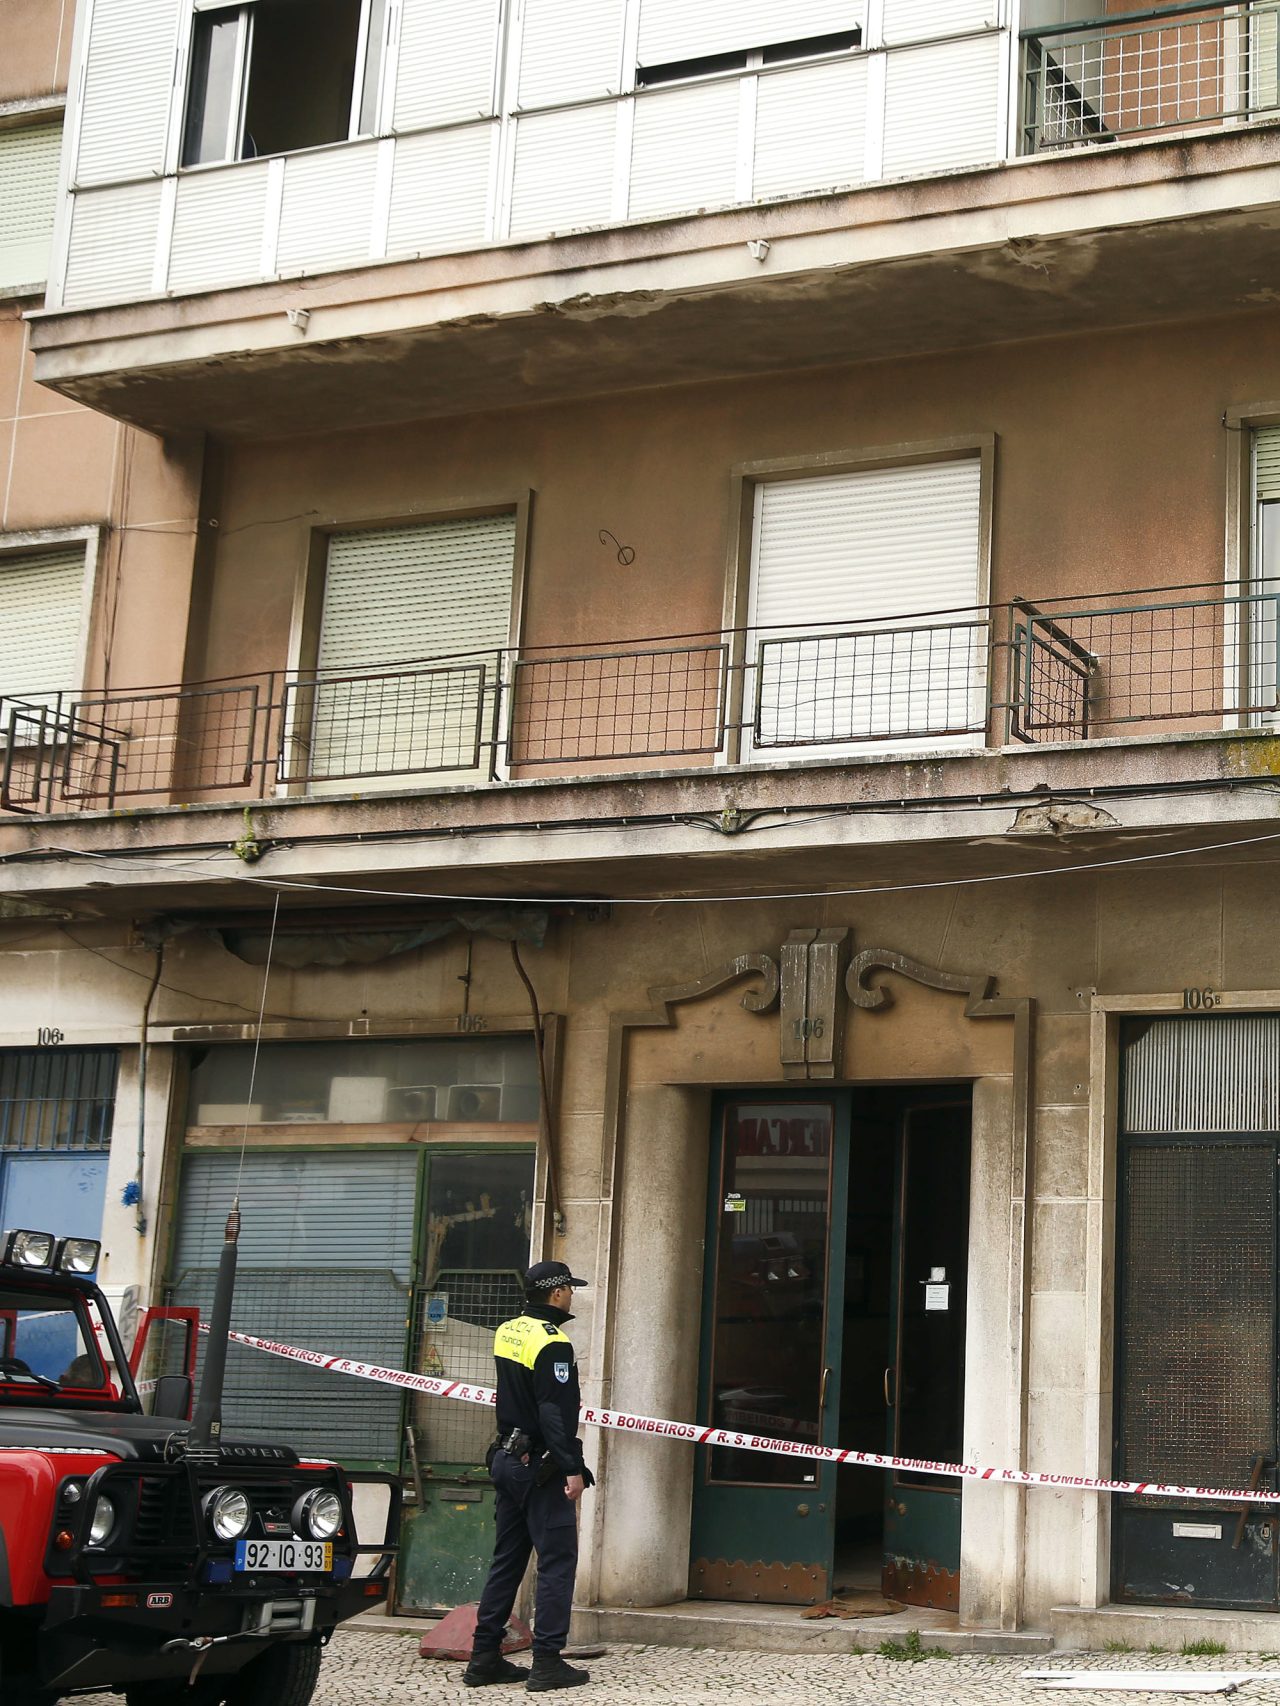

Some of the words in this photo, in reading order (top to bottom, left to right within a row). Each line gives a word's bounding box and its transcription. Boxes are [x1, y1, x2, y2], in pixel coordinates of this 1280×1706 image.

[793, 1017, 824, 1039] 106
[256, 1338, 325, 1364] BOMBEIROS
[340, 1360, 351, 1370] R.
[355, 1364, 366, 1375] S.
[368, 1367, 442, 1392] BOMBEIROS
[459, 1387, 471, 1399] R.
[475, 1389, 486, 1402] S.
[585, 1410, 597, 1422] R.
[601, 1412, 613, 1425] S.
[616, 1415, 697, 1438] BOMBEIROS
[220, 1446, 286, 1459] ROVER
[717, 1431, 730, 1443] R.
[734, 1434, 746, 1446] S.
[751, 1436, 834, 1457] BOMBEIROS
[856, 1452, 869, 1462] R.
[874, 1454, 887, 1464] S.
[891, 1456, 978, 1475] BOMBEIROS
[1002, 1469, 1016, 1479] R.
[1021, 1471, 1034, 1481] S.
[1039, 1474, 1131, 1489] BOMBEIROS
[151, 1596, 170, 1605] ARB
